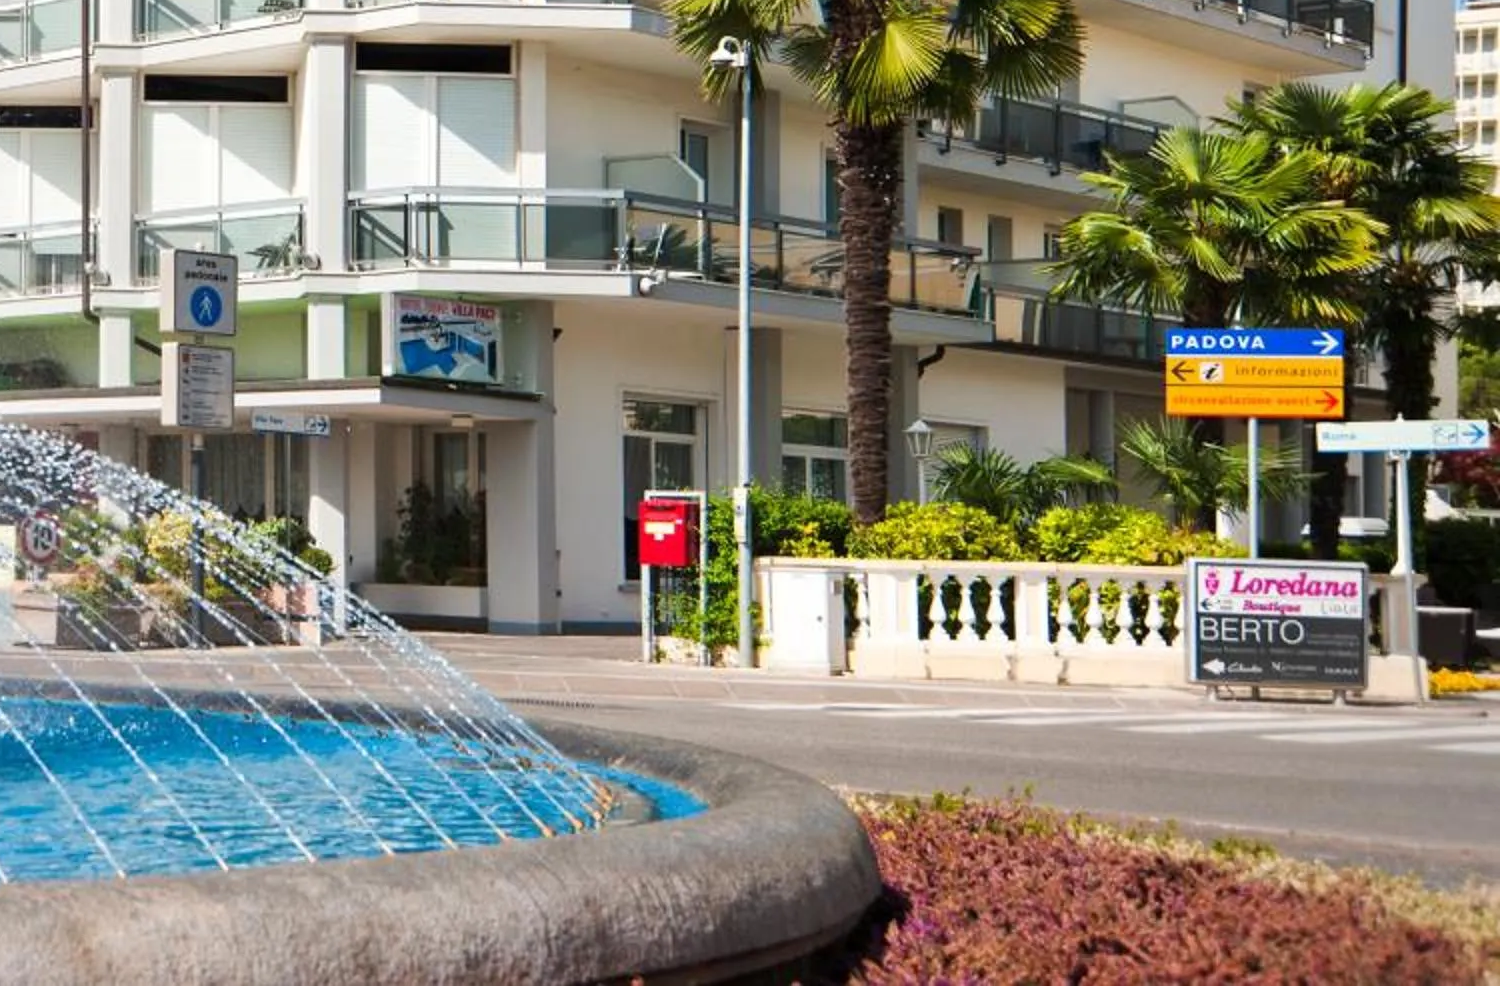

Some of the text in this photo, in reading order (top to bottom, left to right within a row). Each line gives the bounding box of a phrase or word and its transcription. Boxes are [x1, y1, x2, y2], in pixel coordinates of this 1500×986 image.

[1171, 335, 1266, 349] PADOVA
[1235, 365, 1339, 378] informazioni
[1230, 569, 1359, 597] Loredana
[1243, 599, 1302, 615] Boutique
[1200, 617, 1305, 645] BERTO
